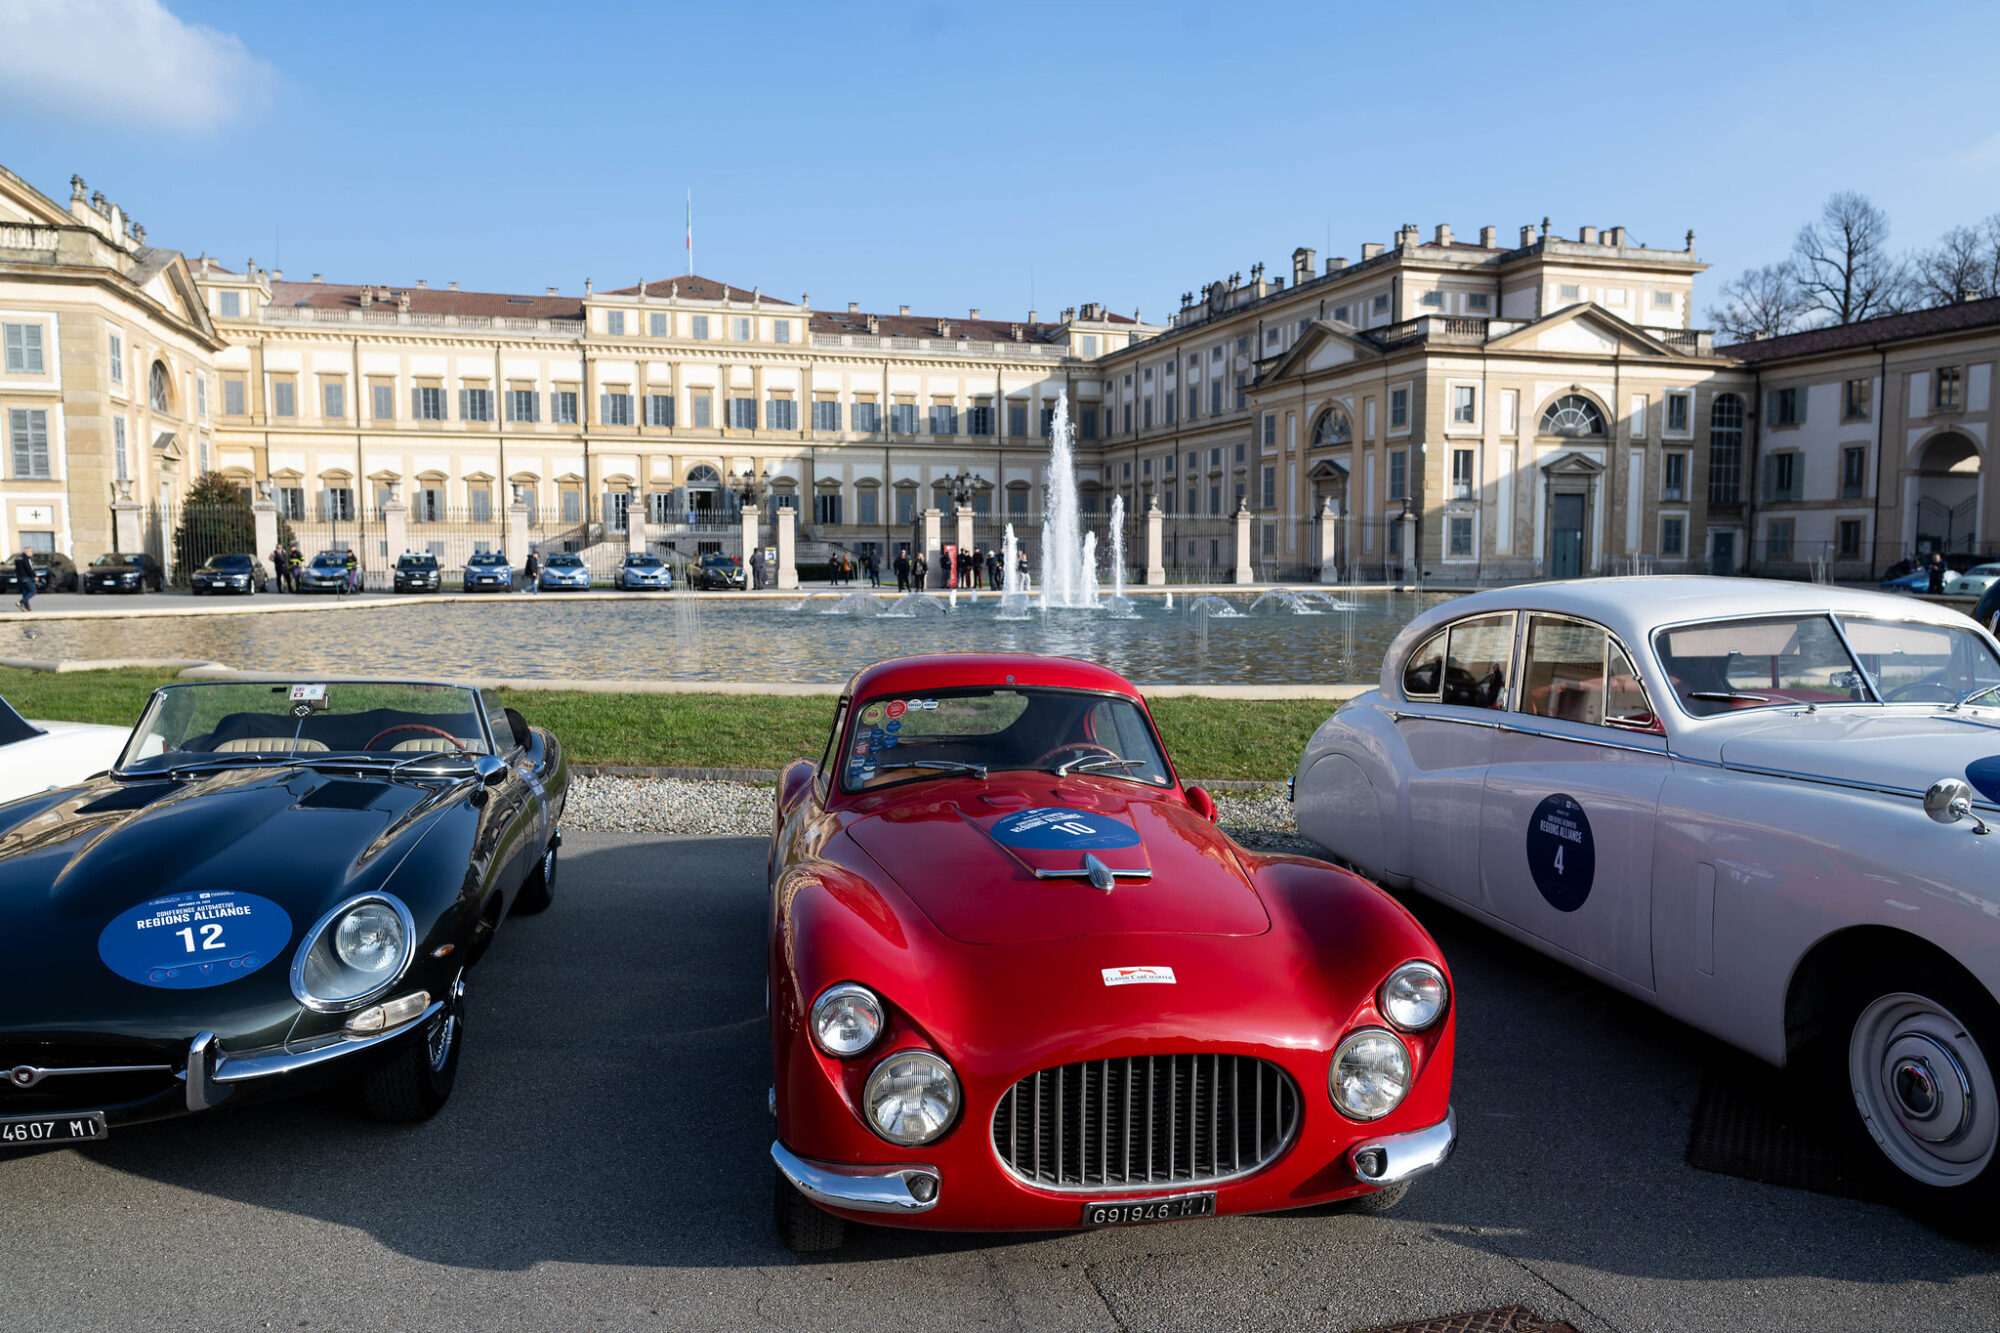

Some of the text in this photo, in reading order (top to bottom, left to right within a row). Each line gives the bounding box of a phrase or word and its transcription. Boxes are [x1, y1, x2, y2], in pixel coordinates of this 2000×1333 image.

[1050, 821, 1097, 836] 10
[1553, 845, 1564, 875] 4
[136, 905, 252, 930] REGIONS ALLIANCE
[156, 902, 234, 918] CONFERENCE AUTOMOTIVE
[175, 923, 226, 953] 12
[2, 1120, 96, 1142] 4607 MI
[1093, 1204, 1169, 1224] G91946
